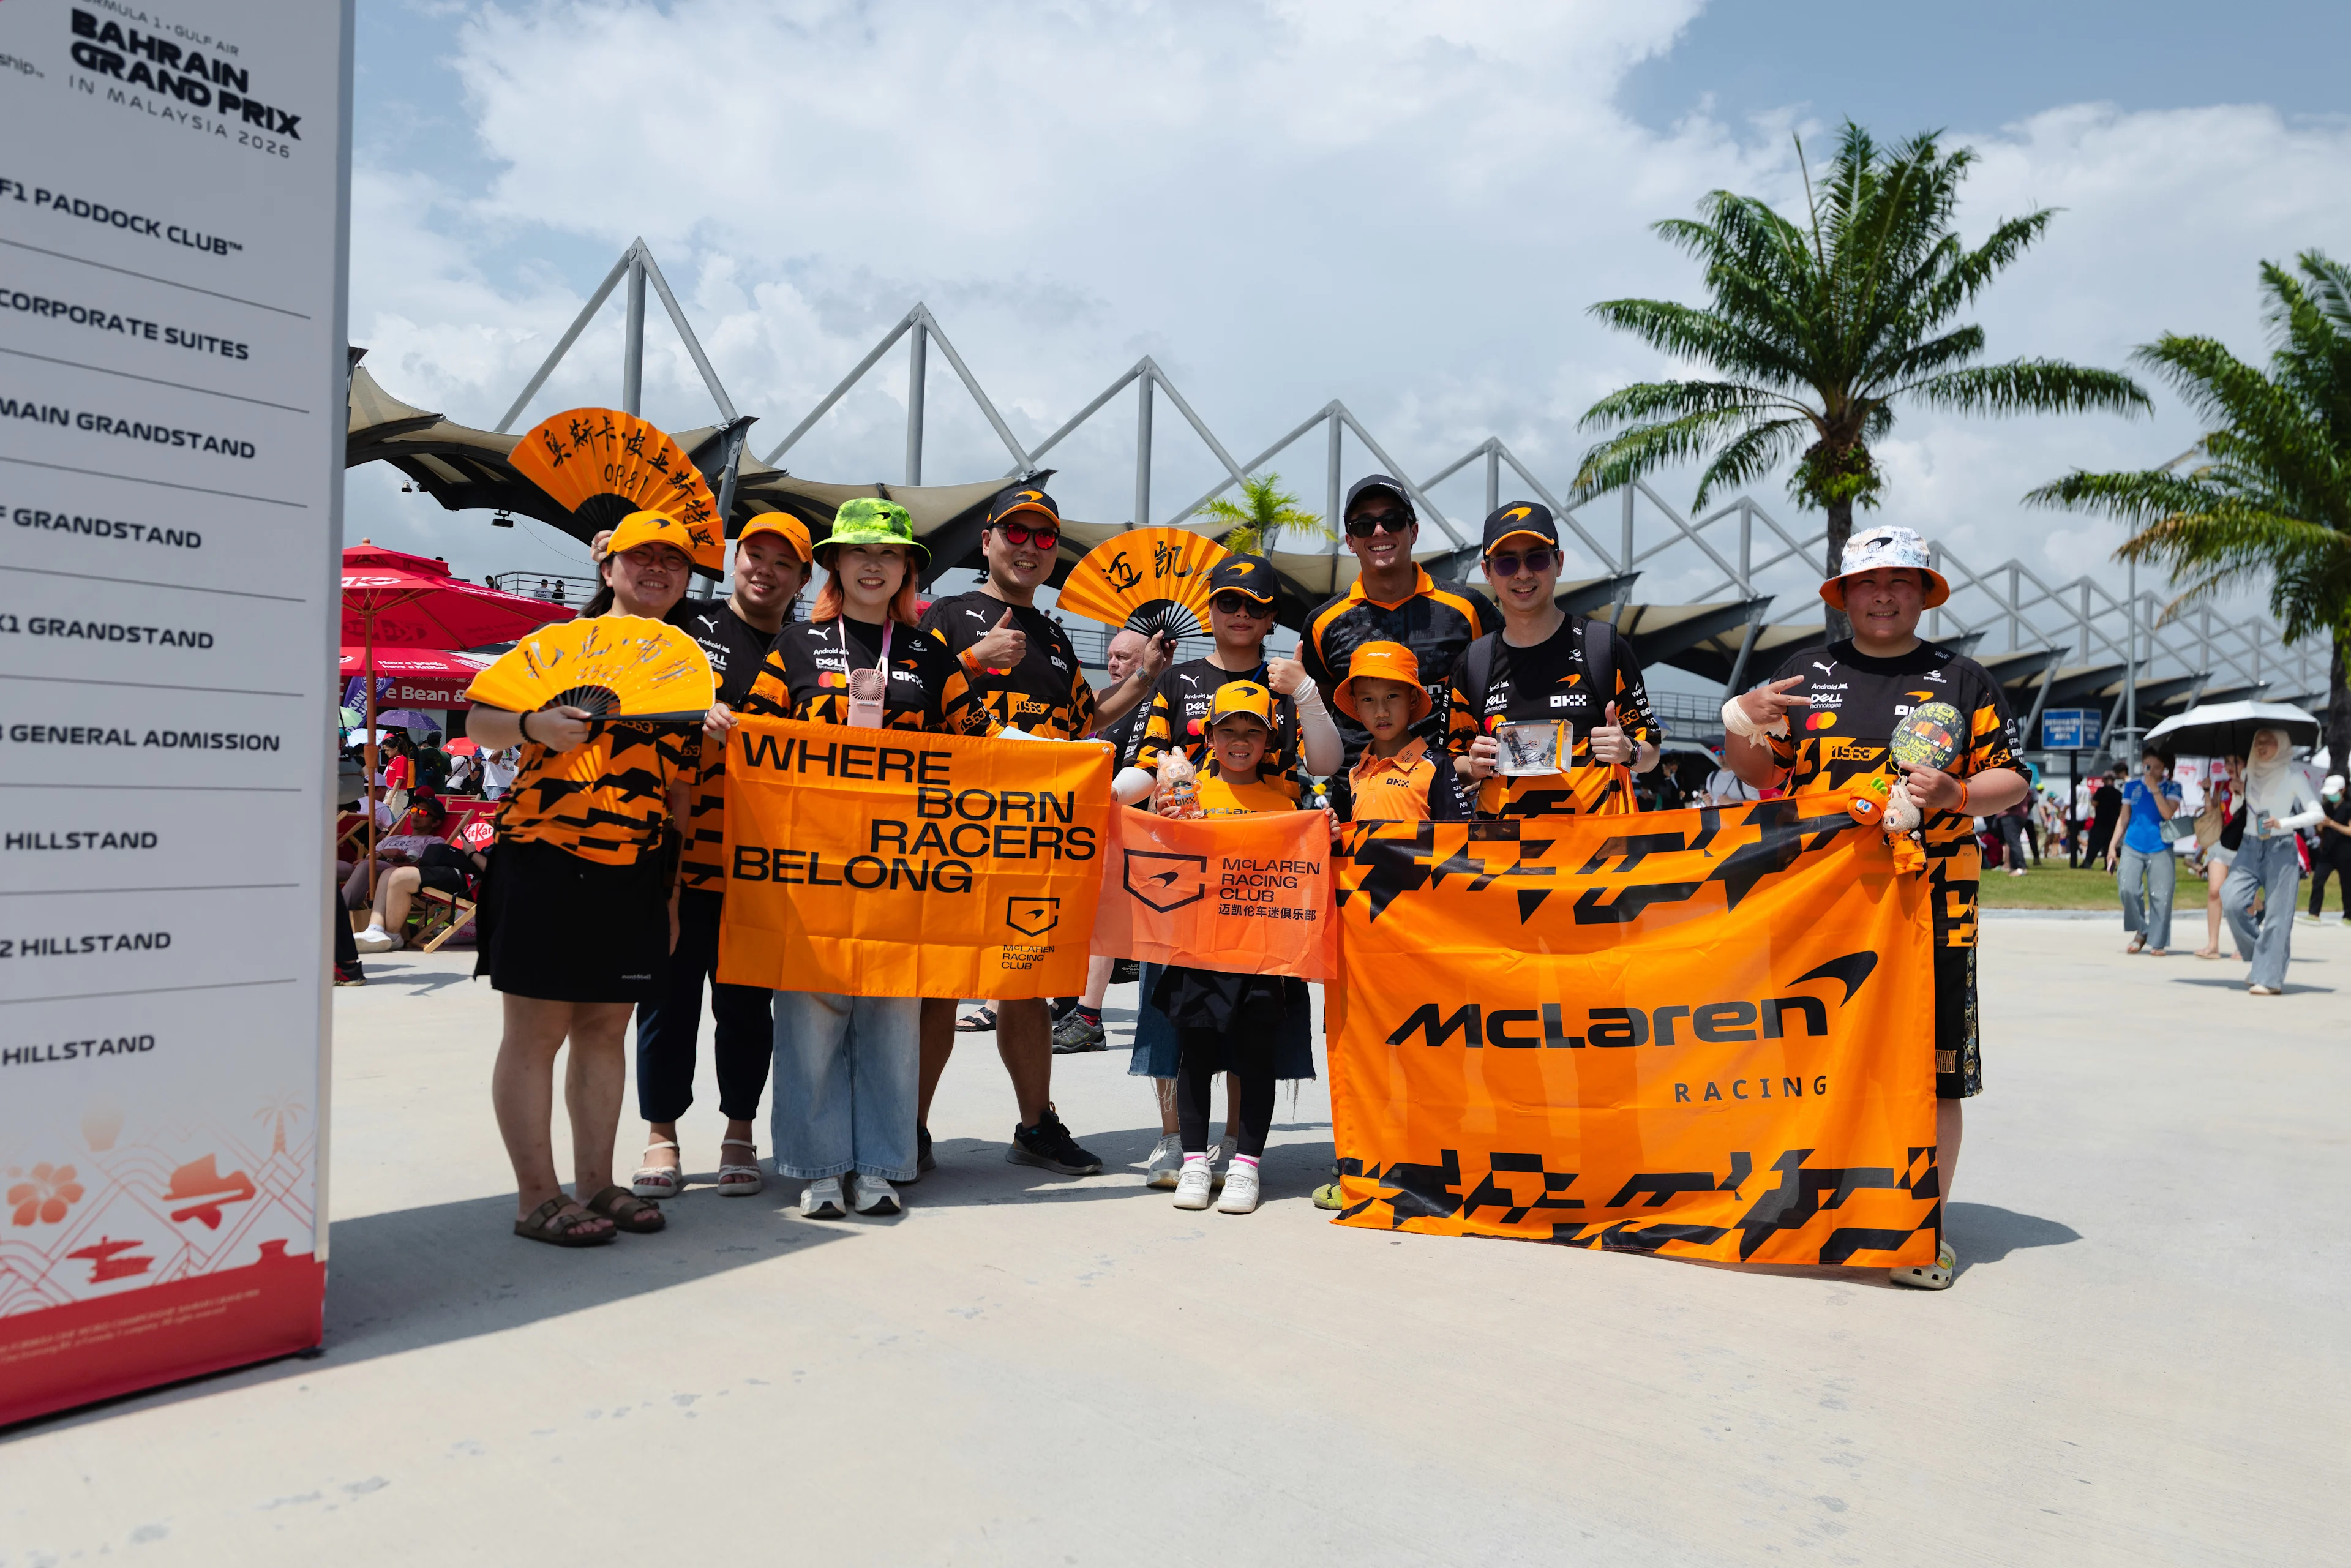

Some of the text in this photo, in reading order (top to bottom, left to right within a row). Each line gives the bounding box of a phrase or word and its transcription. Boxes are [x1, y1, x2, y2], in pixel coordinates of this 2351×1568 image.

[71, 7, 249, 94] BAHRAIN
[174, 24, 212, 45] GULF
[216, 40, 239, 56] AIR
[70, 40, 302, 141] GRAND PRIX
[69, 74, 290, 159] IN MALAYSIA 2026
[0, 178, 27, 202] F1
[34, 187, 162, 239] PADDOCK
[0, 288, 249, 361] CORPORATE SUITES
[0, 397, 256, 459] MAIN GRANDSTAND
[604, 463, 649, 497] OP81
[13, 508, 202, 549] GRANDSTAND
[28, 616, 214, 649] GRANDSTAND
[697, 637, 721, 650] Android
[705, 651, 727, 666] ELL
[816, 658, 846, 666] DELL
[402, 686, 449, 702] Bean
[453, 689, 467, 703] &
[1186, 702, 1209, 711] DEL
[1550, 694, 1587, 708] OKX
[1810, 692, 1843, 703] DELL
[9, 724, 137, 748] GENERAL
[143, 729, 280, 752] ADMISSION
[741, 732, 953, 786] WHERE
[1386, 778, 1409, 788] OKX
[917, 786, 1074, 823] BORN
[5, 831, 159, 850] HILLSTAND
[462, 823, 494, 841] KitKat
[870, 819, 1097, 861] RACERS
[732, 845, 973, 893] BELONG
[1223, 858, 1320, 874] McLAREN
[1221, 873, 1297, 888] RACING
[1220, 888, 1274, 902] CLUB
[1218, 903, 1316, 921] 迈凯伦车迷俱乐部
[20, 932, 172, 957] HILLSTAND
[1002, 953, 1044, 962] RACING
[1003, 944, 1055, 953] McLAREN
[1001, 961, 1032, 970] CLUB
[1385, 995, 1828, 1048] McLaren
[2, 1034, 156, 1066] HILLSTAND
[1674, 1075, 1828, 1103] RACING
